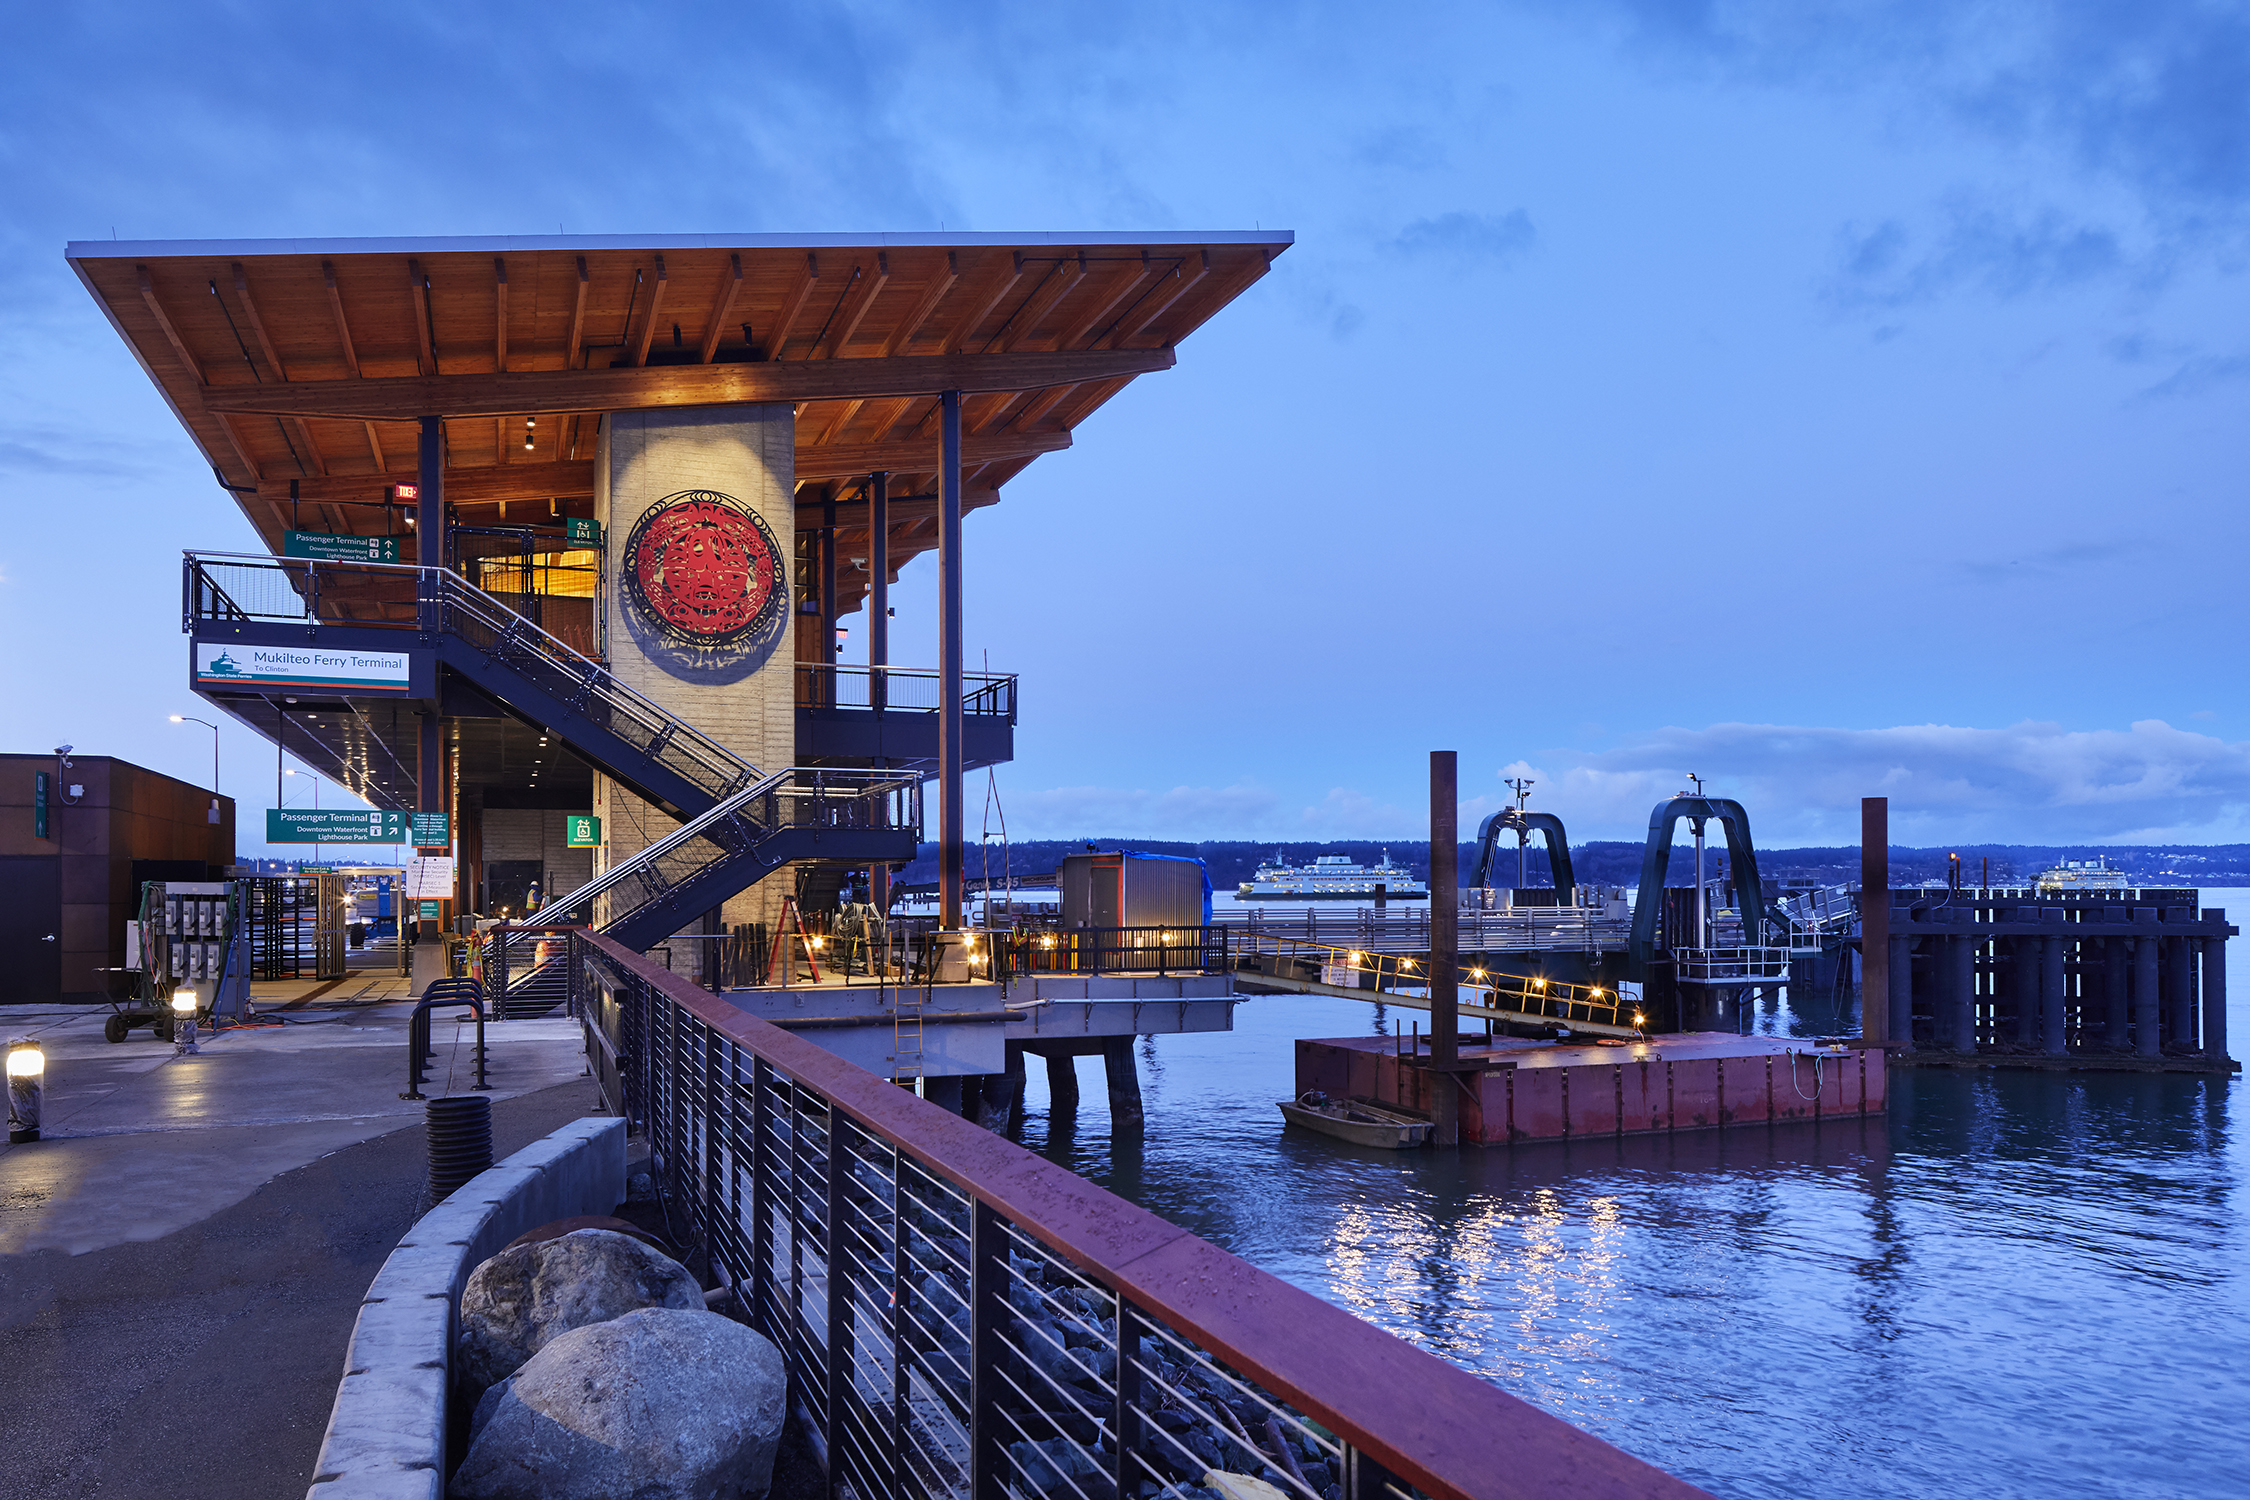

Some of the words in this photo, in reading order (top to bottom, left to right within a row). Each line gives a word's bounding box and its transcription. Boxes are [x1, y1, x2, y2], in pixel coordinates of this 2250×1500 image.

[296, 534, 335, 545] Passenger
[336, 537, 368, 546] Terminal
[254, 652, 310, 664] Mukilteo
[314, 654, 346, 668] Ferry
[350, 656, 402, 668] Terminal
[280, 812, 328, 823] Passenger
[329, 814, 368, 822] Terminal
